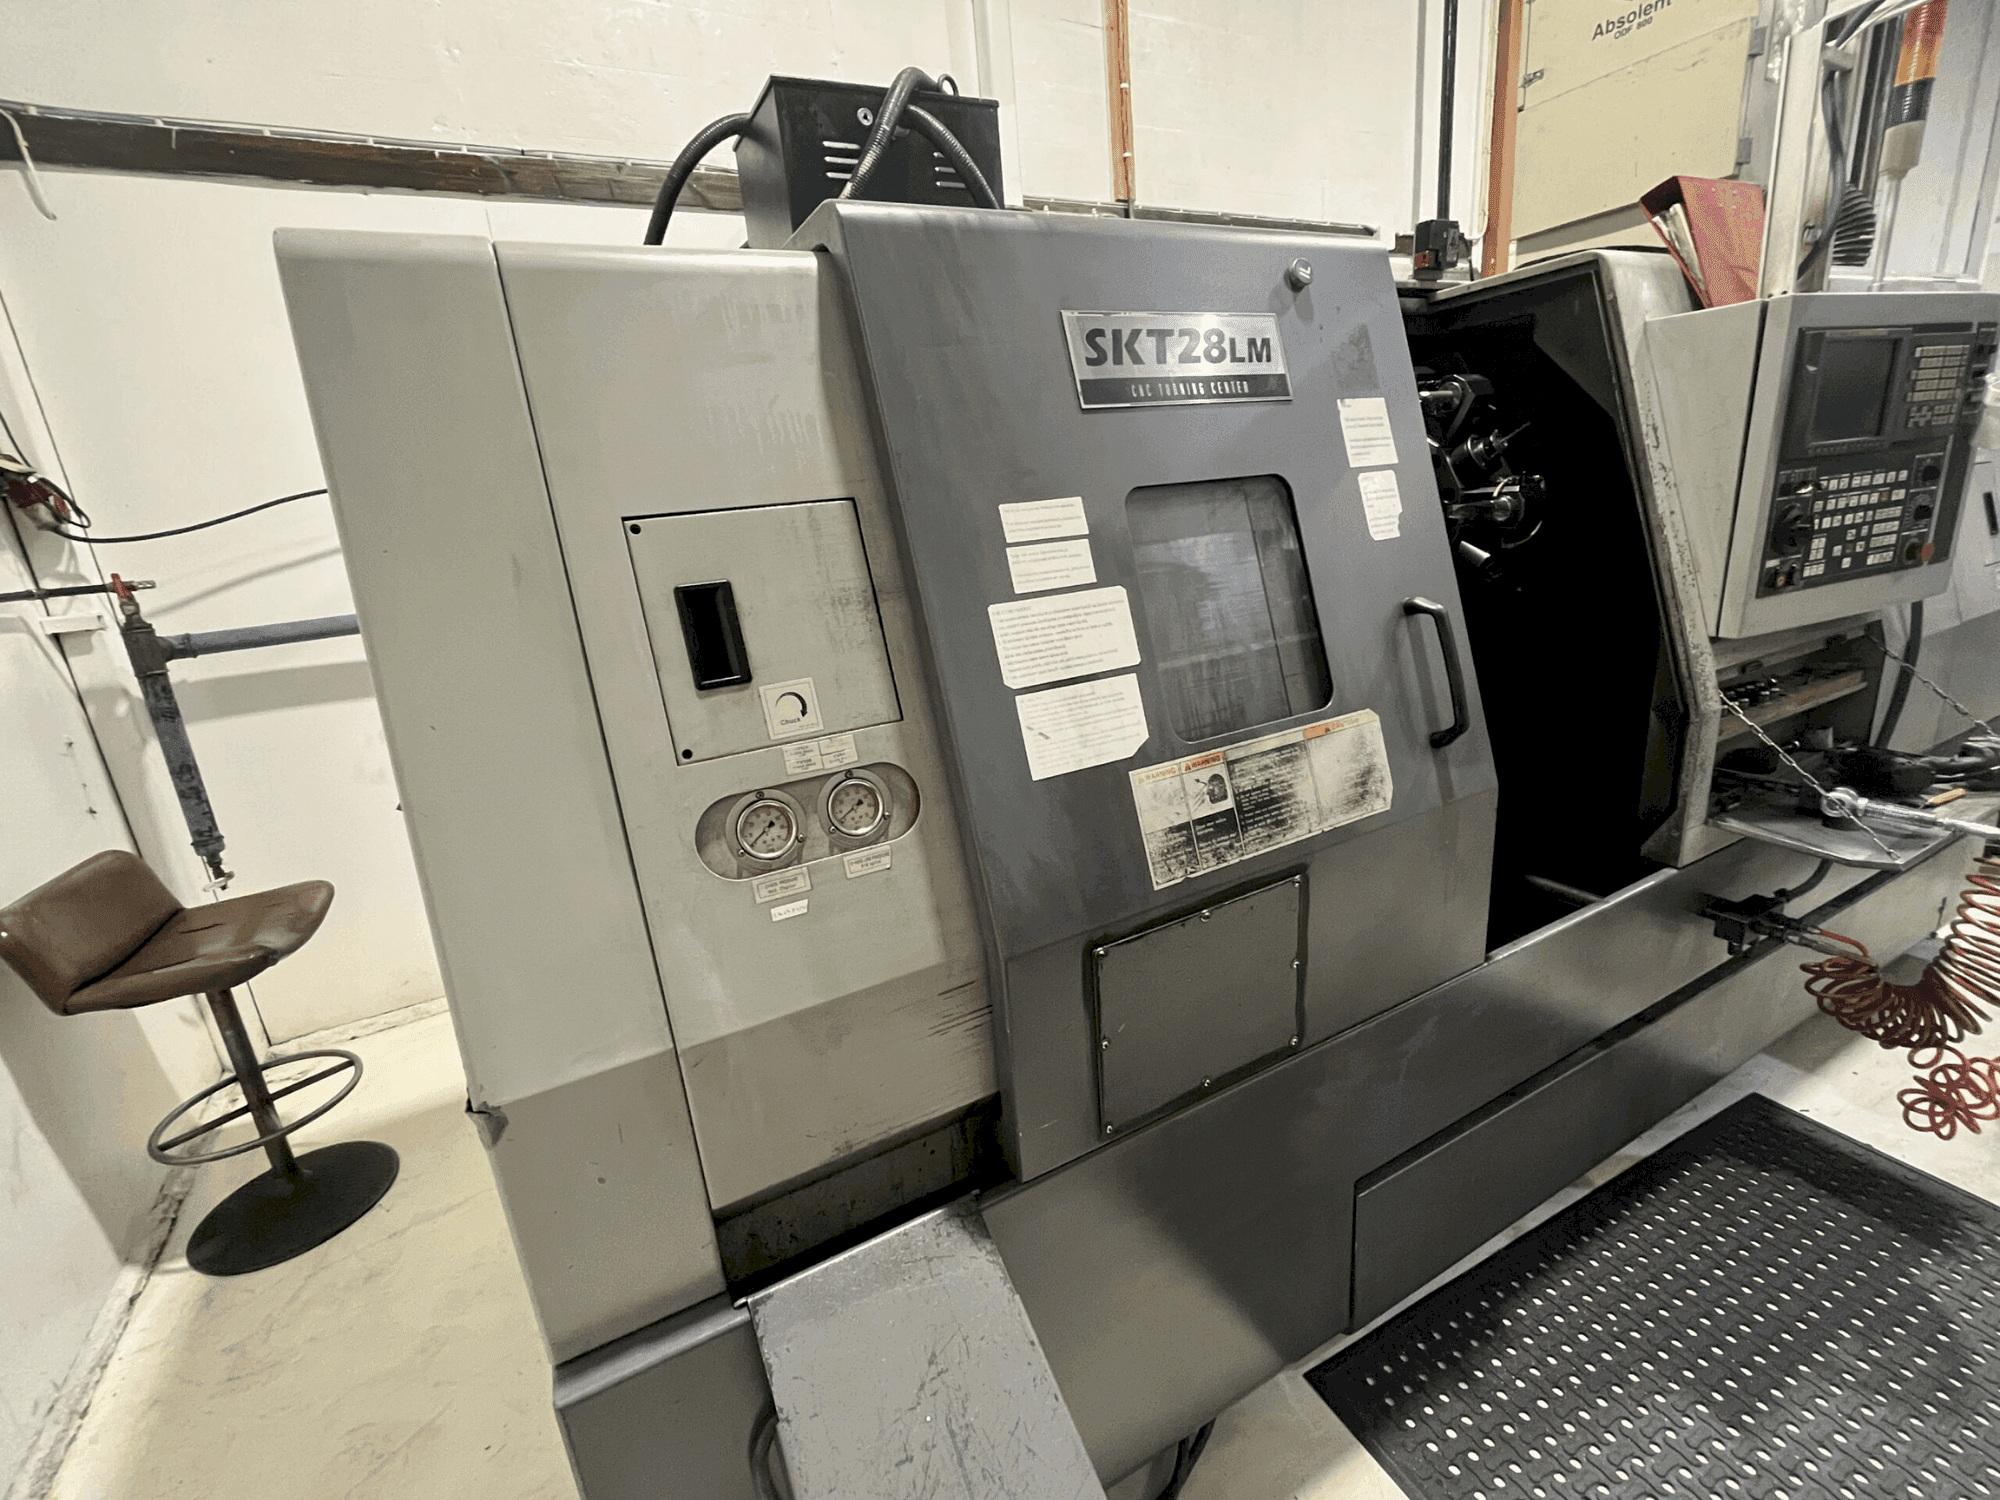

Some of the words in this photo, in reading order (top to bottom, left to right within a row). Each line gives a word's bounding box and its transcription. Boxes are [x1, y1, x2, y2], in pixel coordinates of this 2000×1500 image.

[1614, 25, 1633, 40] ODF
[1084, 327, 1272, 367] SKT28LM
[1131, 384, 1153, 398] CNC
[1158, 382, 1206, 397] TURNING
[1210, 381, 1250, 395] CENTER
[780, 717, 801, 726] Chuck
[1191, 755, 1222, 769] WARNING
[1145, 767, 1177, 781] WARNING
